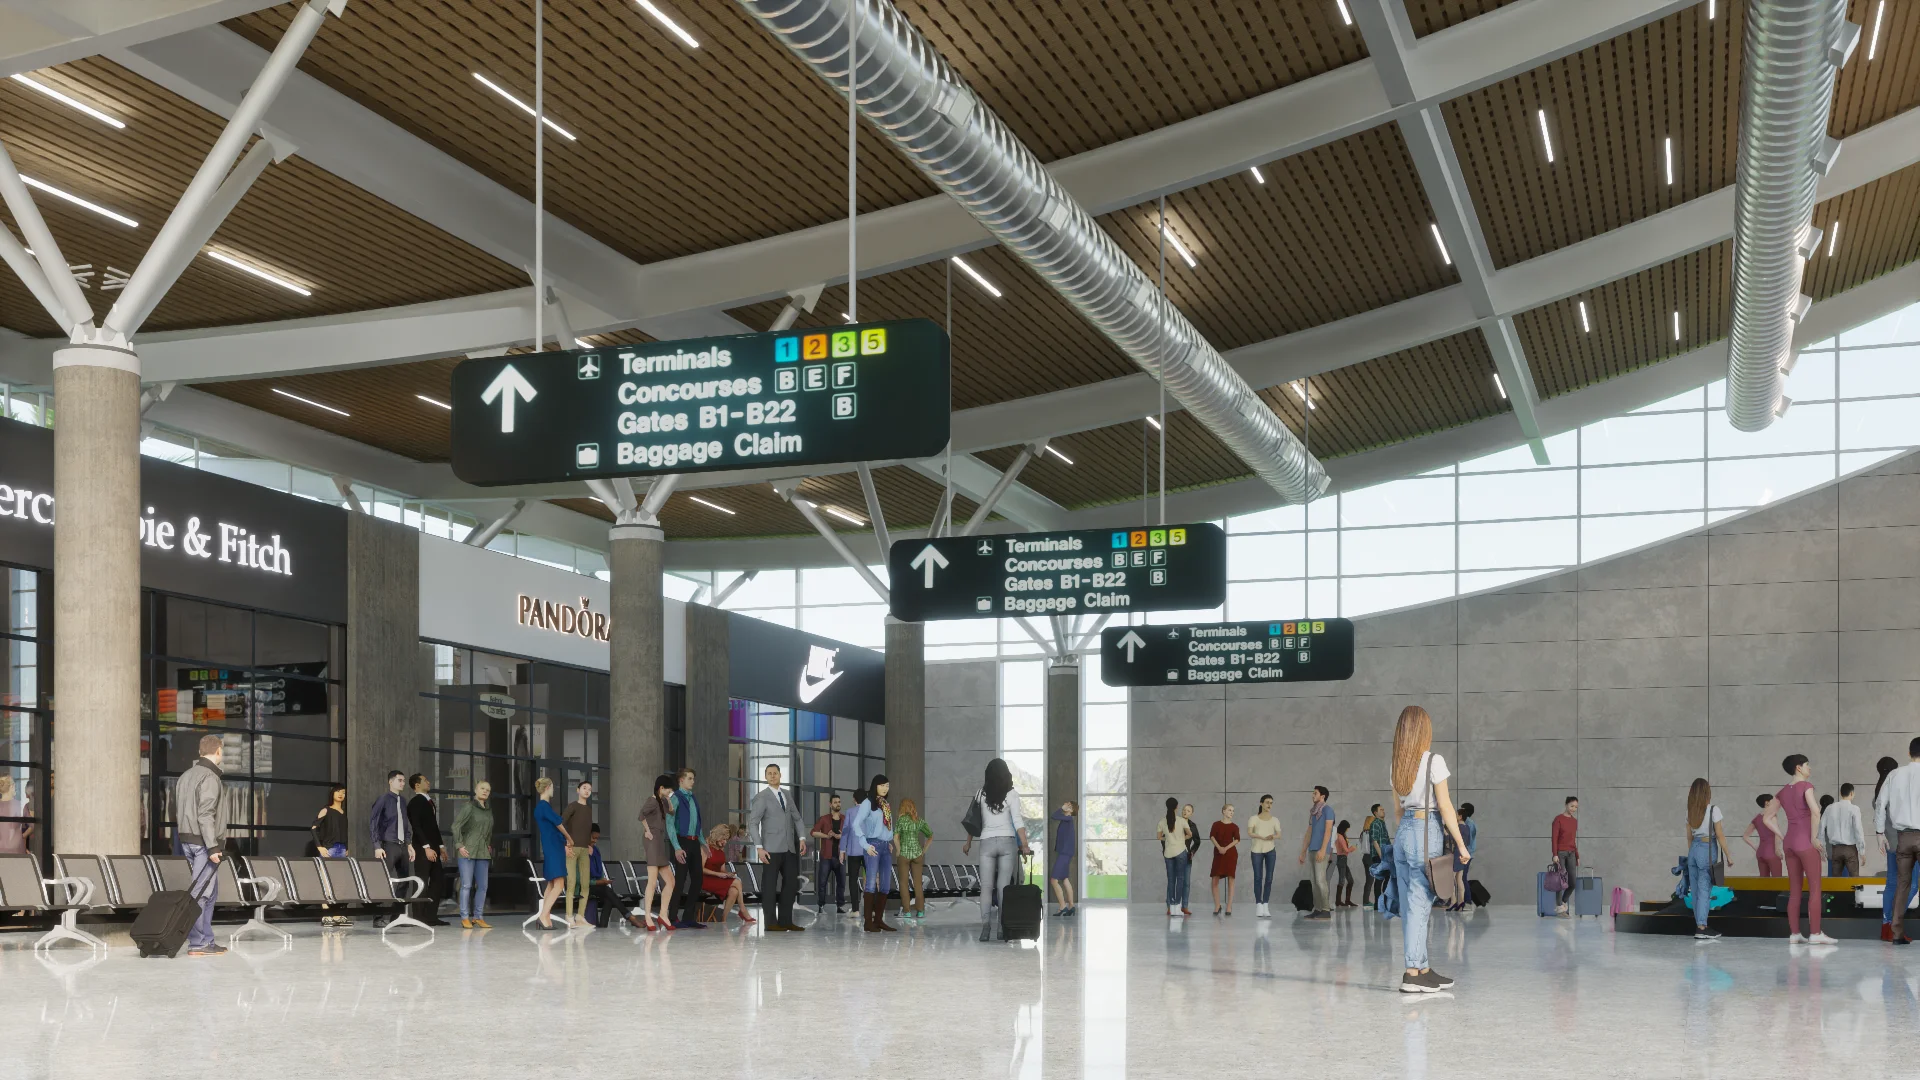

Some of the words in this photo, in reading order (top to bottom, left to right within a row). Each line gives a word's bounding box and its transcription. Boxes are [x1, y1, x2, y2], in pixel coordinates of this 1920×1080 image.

[618, 347, 732, 375] Terminals
[618, 377, 763, 406] Concourses
[618, 411, 688, 435] Gates
[700, 400, 796, 428] B1-B22
[618, 441, 723, 467] Baggage
[734, 432, 802, 456] Claim
[183, 516, 211, 558] &
[218, 522, 292, 576] Fitch
[1006, 537, 1082, 553] Terminals
[1005, 557, 1103, 574] Concourses
[1005, 577, 1053, 591] Gates
[1061, 572, 1126, 589] B1-B22
[1005, 597, 1076, 613] Baggage
[1084, 592, 1130, 607] Claim
[518, 595, 610, 642] PANDOR
[1189, 626, 1247, 637] Terminals
[1189, 641, 1262, 652] Concourses
[1188, 655, 1225, 666] Gates
[1188, 670, 1242, 682] Baggage
[1248, 667, 1282, 678] Claim
